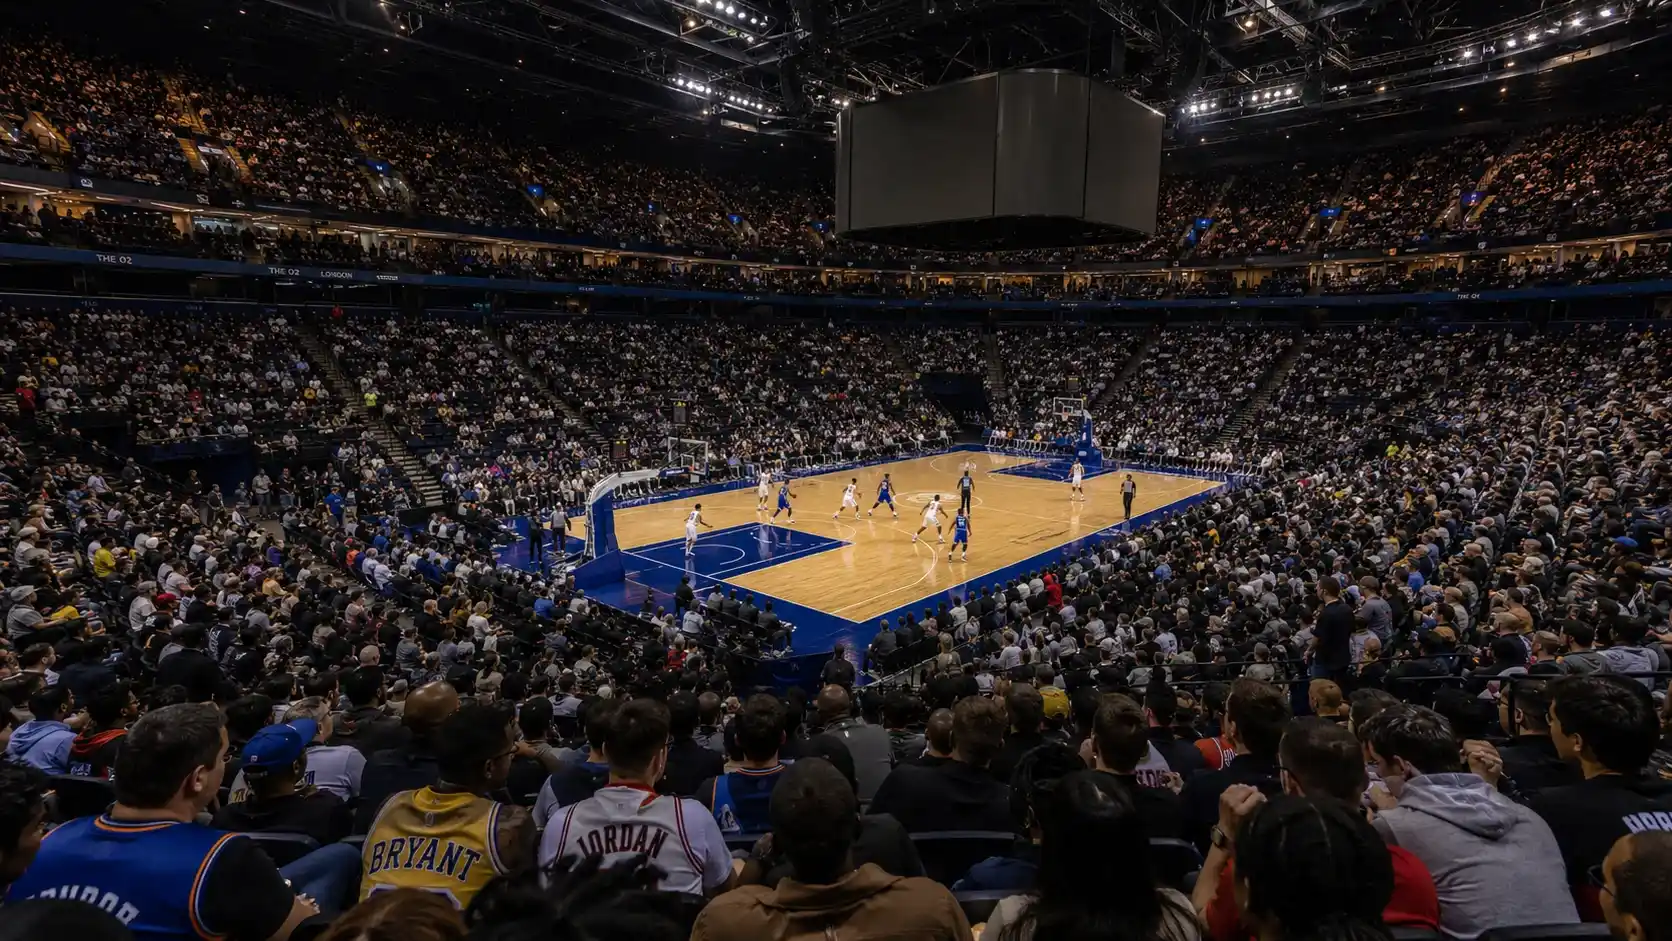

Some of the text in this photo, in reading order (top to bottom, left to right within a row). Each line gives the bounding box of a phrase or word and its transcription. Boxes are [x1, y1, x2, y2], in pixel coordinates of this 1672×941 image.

[96, 254, 117, 263] THE
[268, 266, 287, 275] THE
[320, 270, 353, 279] LONDON
[368, 835, 483, 882] BRYANT
